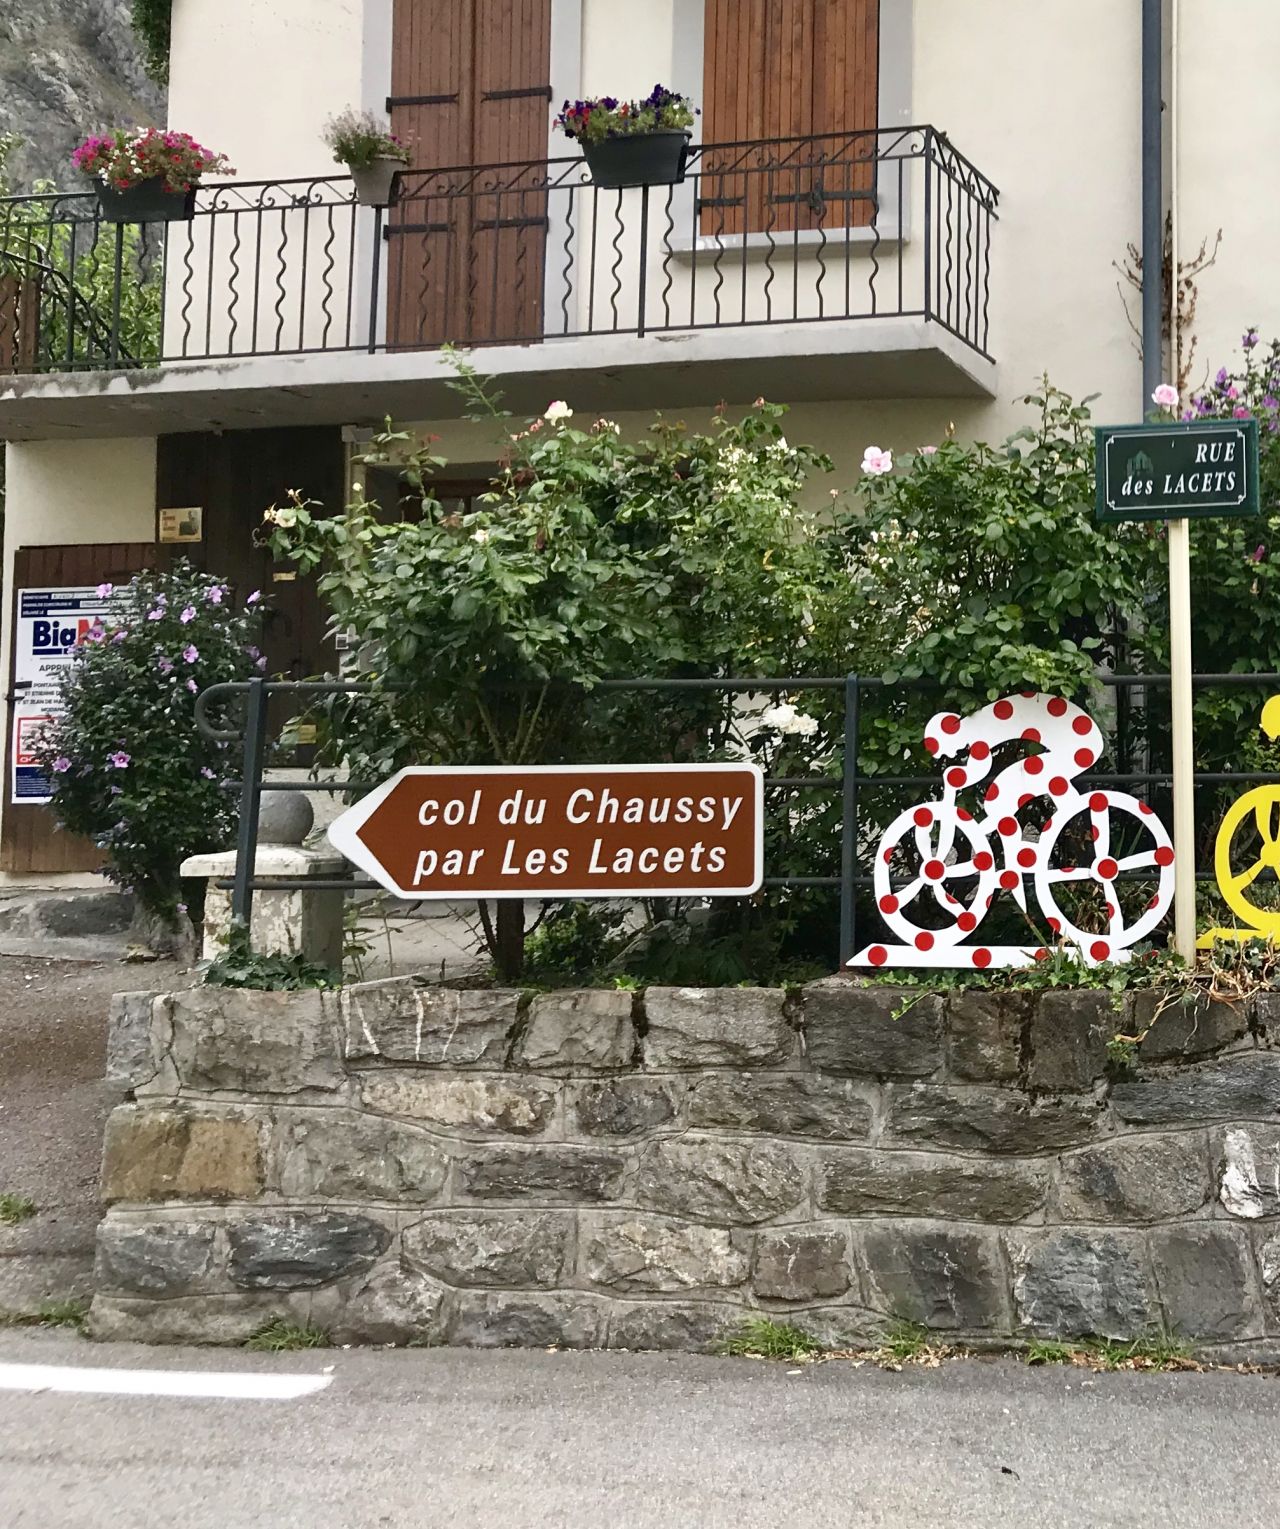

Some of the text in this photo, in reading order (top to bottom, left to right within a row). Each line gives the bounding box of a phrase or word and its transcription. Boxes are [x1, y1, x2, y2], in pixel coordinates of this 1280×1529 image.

[1194, 442, 1236, 464] RUE
[1121, 470, 1236, 496] des LACETS
[418, 788, 744, 831] col du Chaussy
[412, 838, 728, 887] par Les Lacets
